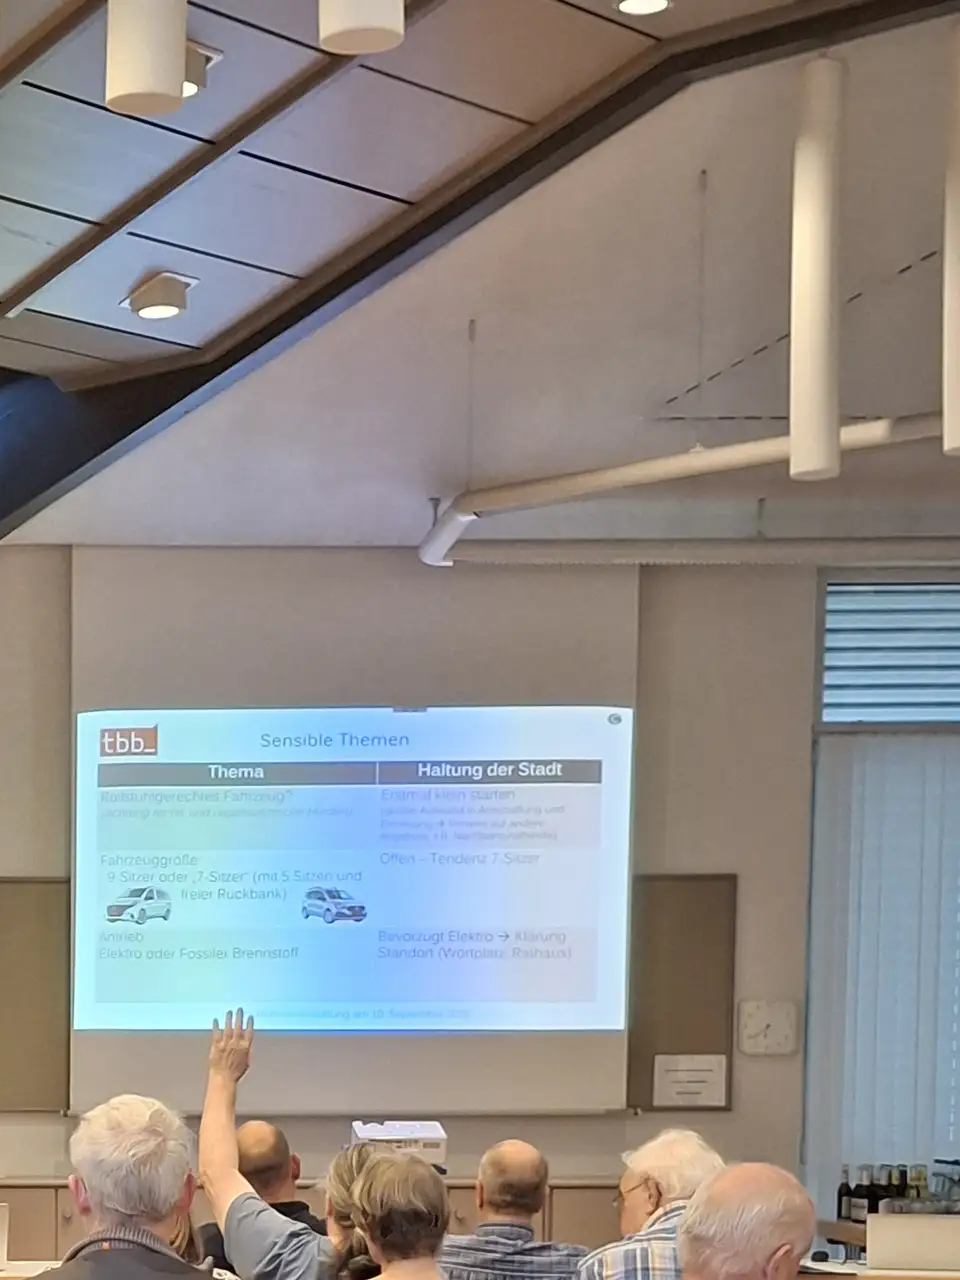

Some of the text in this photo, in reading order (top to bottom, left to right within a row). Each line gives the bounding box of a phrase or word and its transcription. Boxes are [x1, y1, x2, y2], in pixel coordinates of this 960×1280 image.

[260, 732, 409, 748] Sensible Themen
[208, 764, 264, 779] Thema
[417, 761, 562, 780] Haltung der Stadt
[158, 870, 189, 883] oder
[337, 870, 363, 881] und
[448, 930, 493, 942] Elektro
[98, 948, 143, 960] Elektro
[146, 948, 176, 960] oder
[232, 947, 299, 960] Brennstoff
